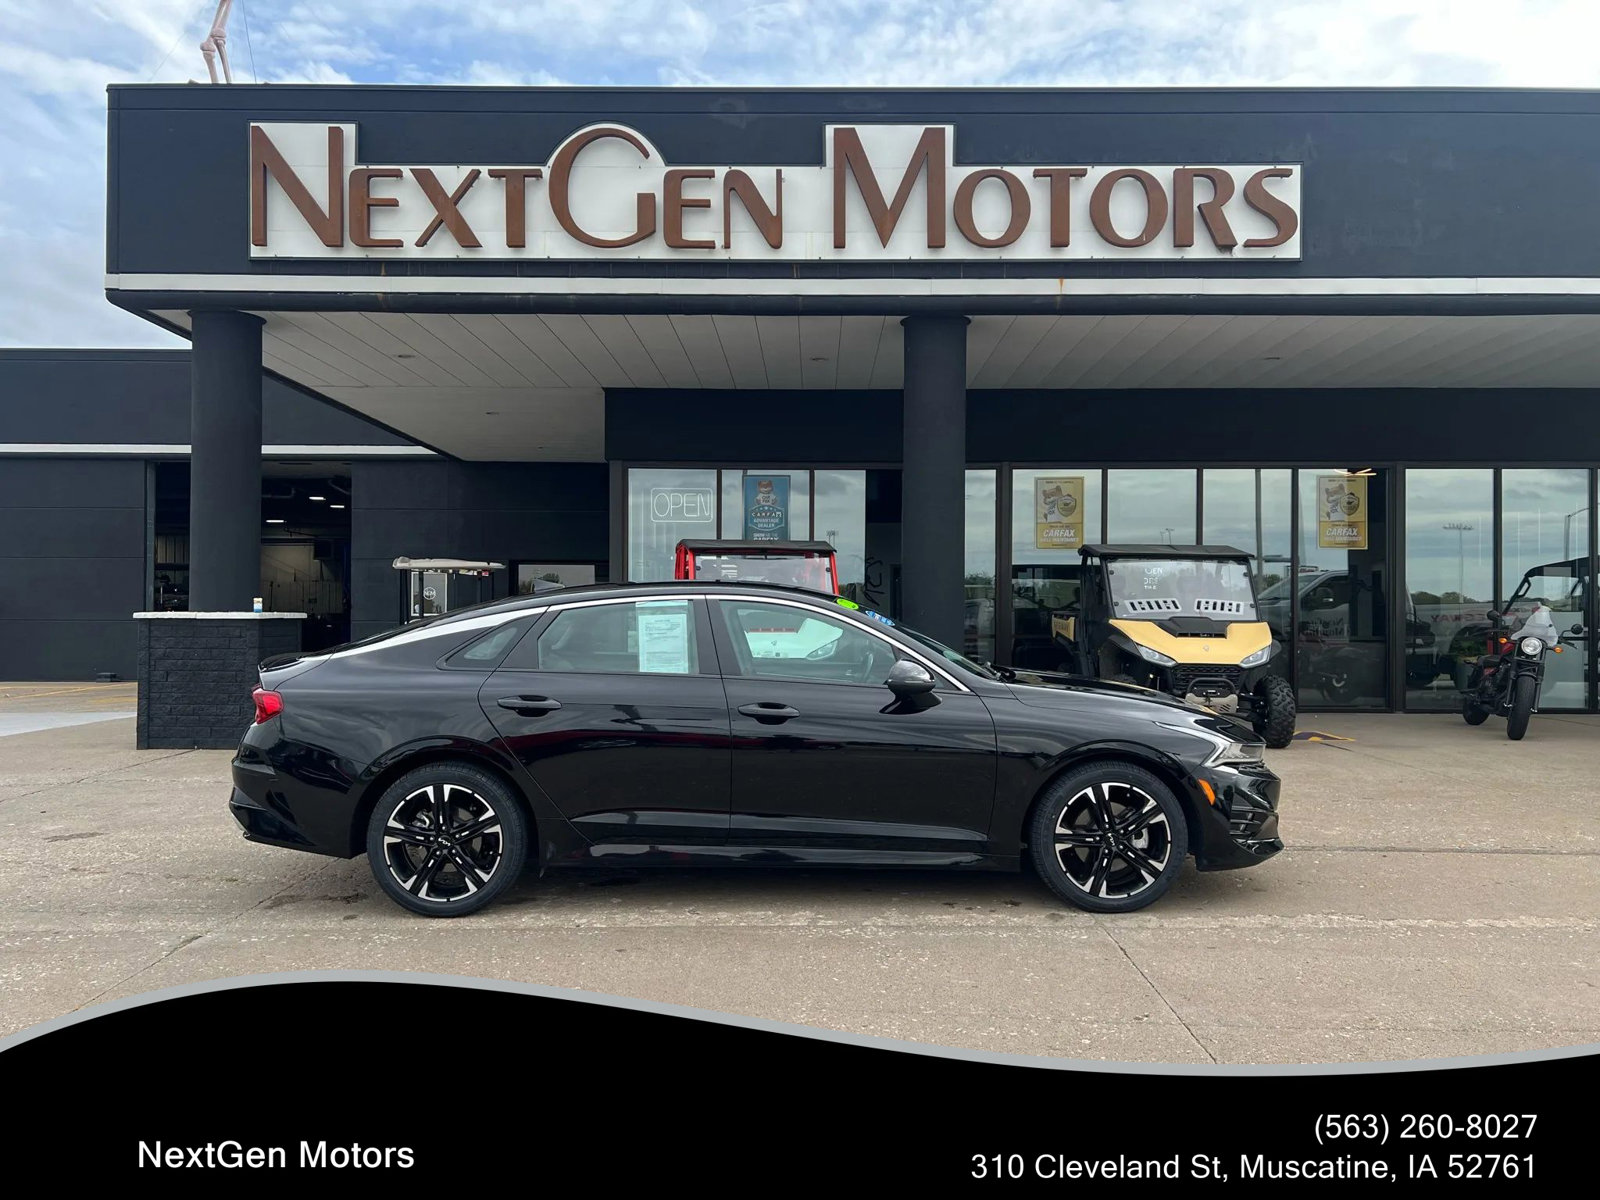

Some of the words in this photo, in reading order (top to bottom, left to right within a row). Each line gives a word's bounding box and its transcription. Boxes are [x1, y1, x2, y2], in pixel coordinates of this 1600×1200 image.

[833, 127, 1299, 250] MOTORS
[653, 493, 711, 517] OPEN
[1043, 529, 1076, 537] CARFAX
[1326, 527, 1359, 537] CARFAX
